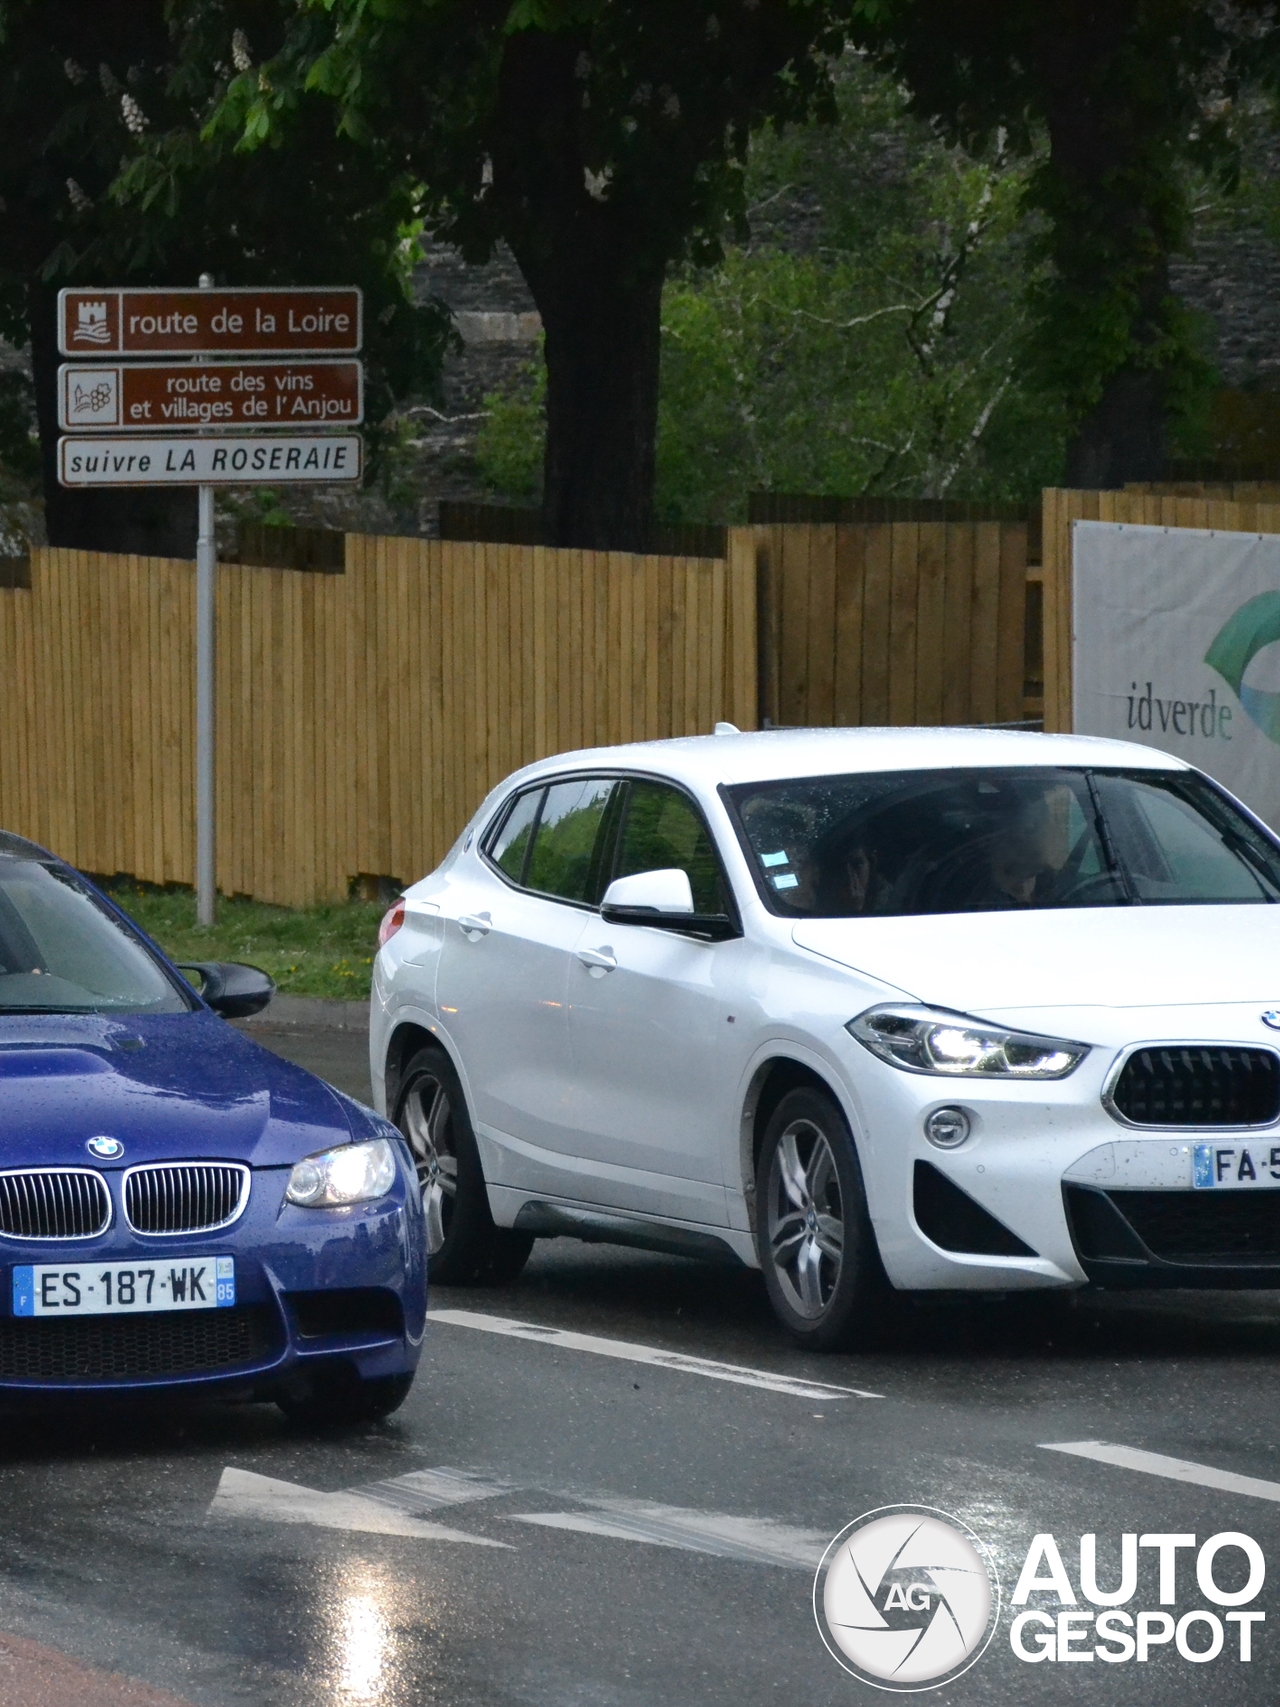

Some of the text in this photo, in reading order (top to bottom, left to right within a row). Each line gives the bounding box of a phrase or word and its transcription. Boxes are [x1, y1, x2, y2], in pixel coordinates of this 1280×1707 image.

[129, 306, 350, 335] route de la Loire
[166, 370, 314, 394] route des vins
[129, 401, 152, 419] et
[160, 397, 234, 423] villages
[241, 396, 268, 416] de
[70, 446, 348, 473] suivre LA ROSERAIE
[1126, 681, 1233, 741] idverde
[41, 1266, 207, 1307] ES-187-WK
[217, 1283, 234, 1301] 85
[20, 1295, 27, 1306] F
